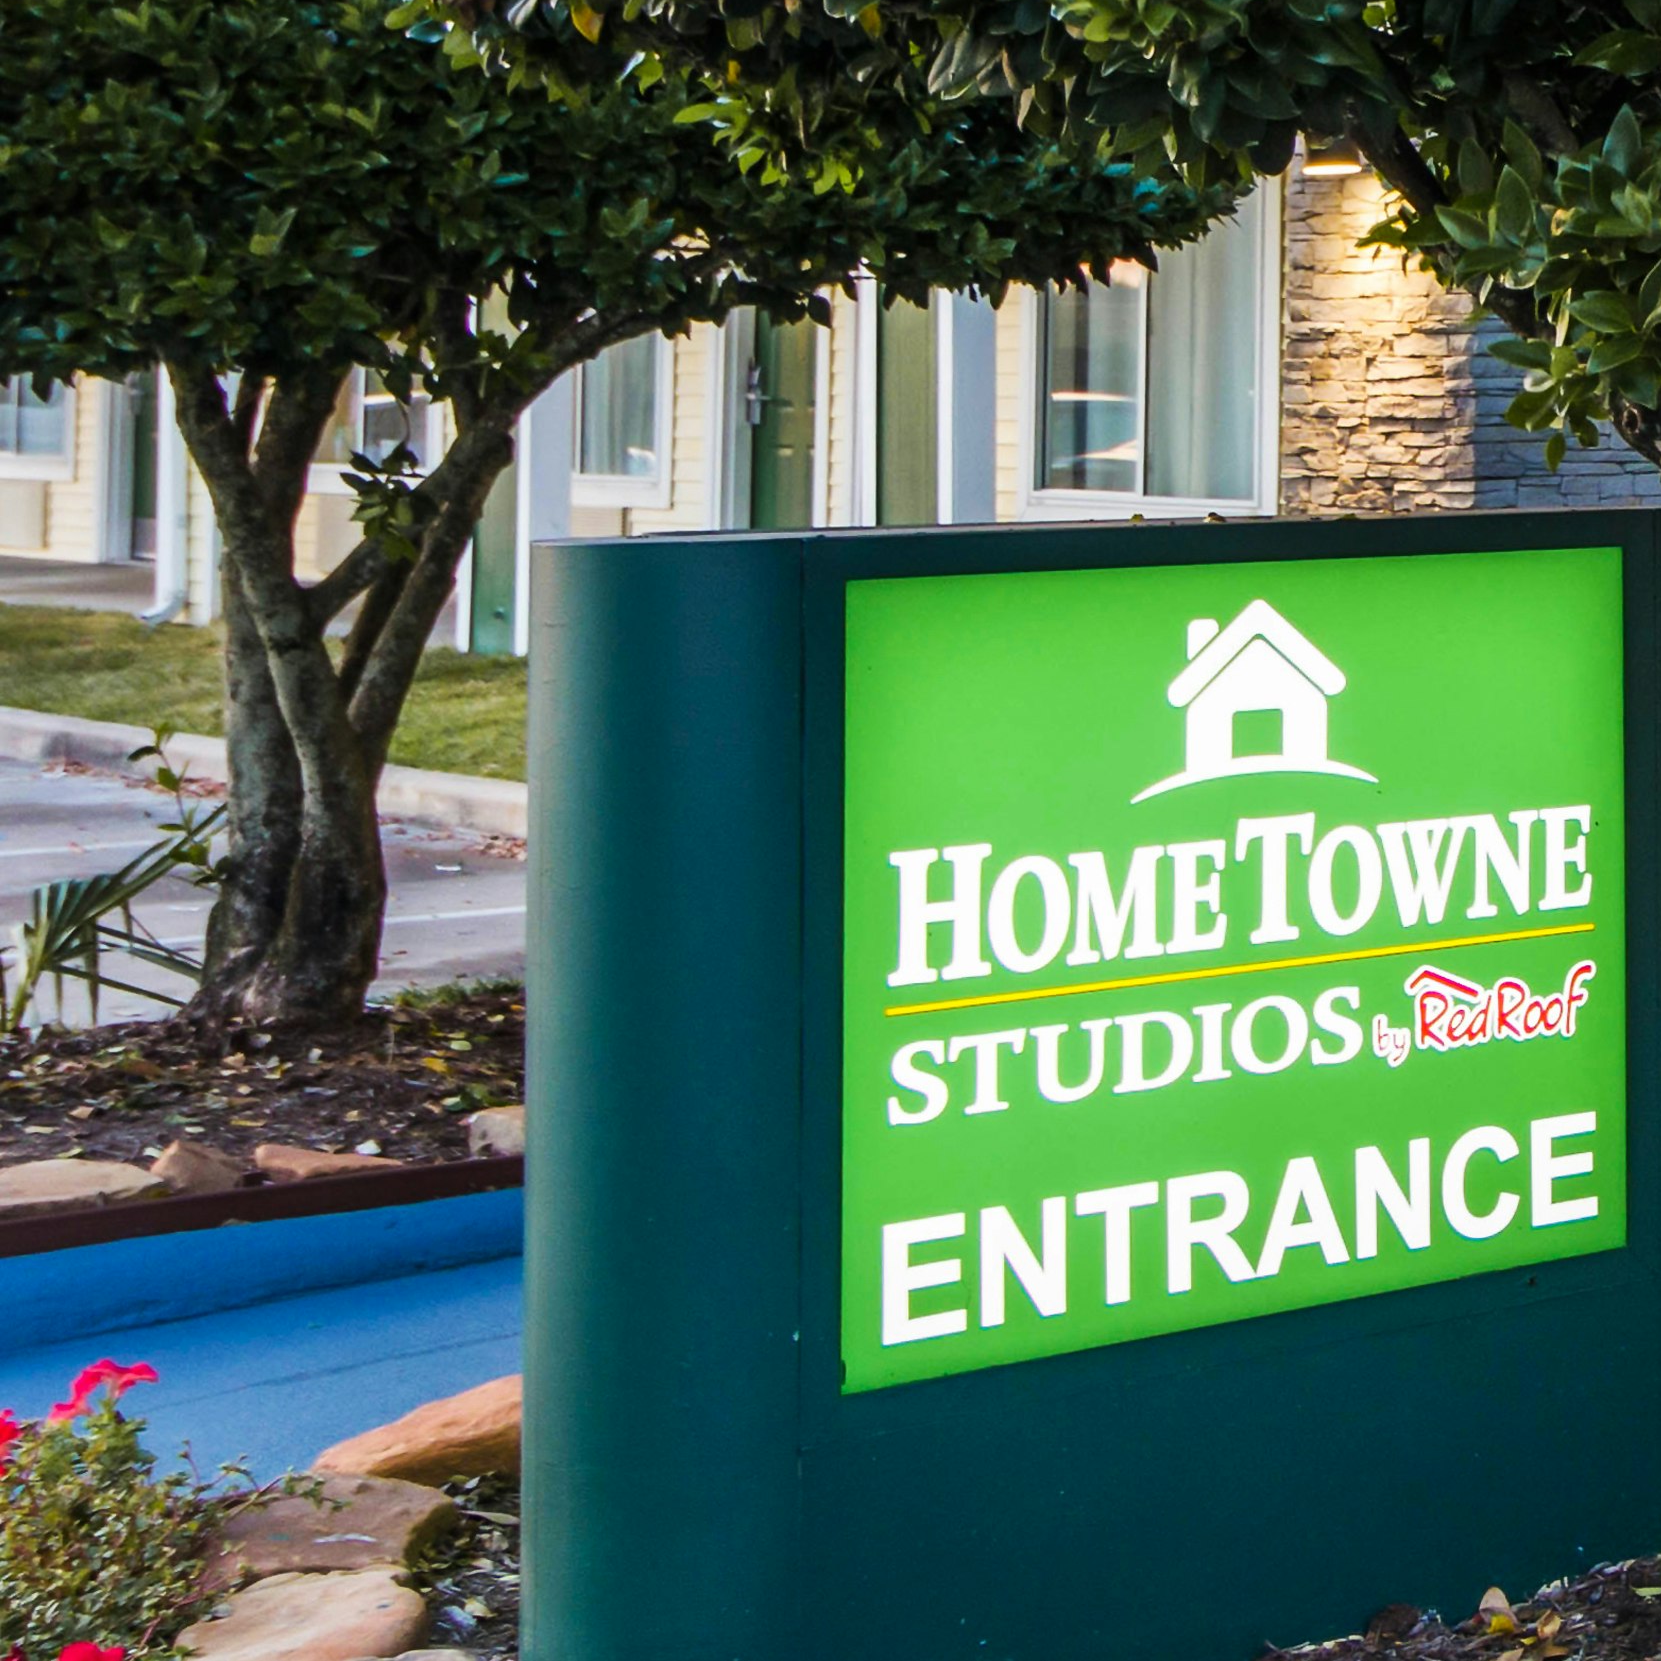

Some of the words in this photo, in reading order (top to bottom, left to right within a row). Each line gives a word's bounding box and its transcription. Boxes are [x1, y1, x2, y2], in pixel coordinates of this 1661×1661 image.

[887, 985, 1364, 1126] STUDIOS
[1372, 1013, 1412, 1068] by
[881, 1111, 1599, 1346] ENTRANCE
